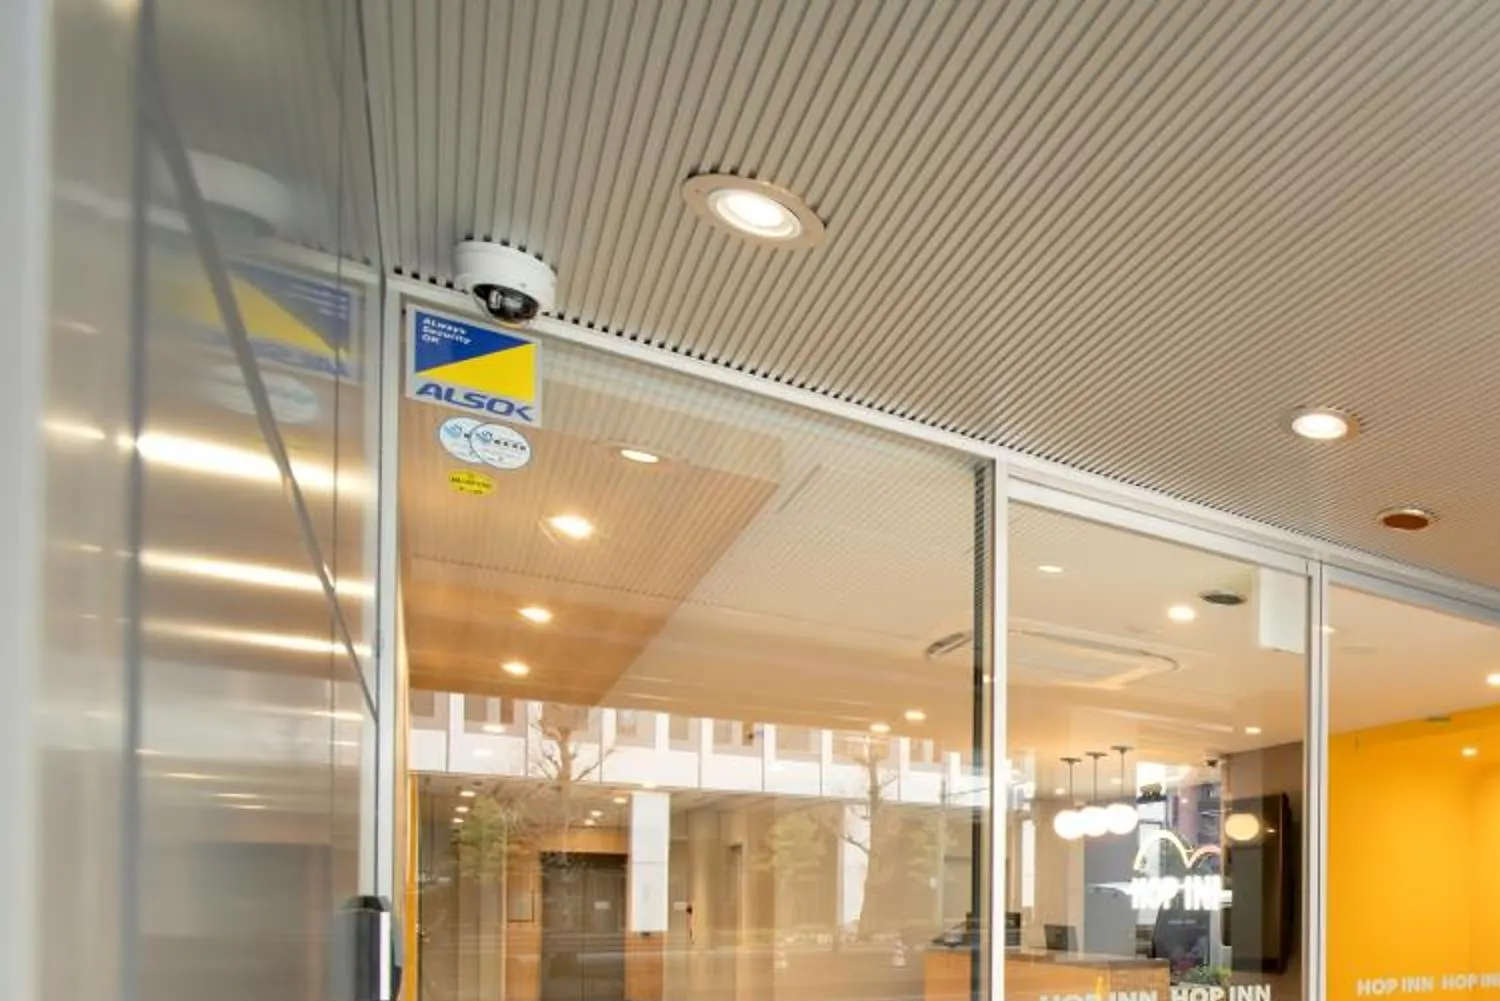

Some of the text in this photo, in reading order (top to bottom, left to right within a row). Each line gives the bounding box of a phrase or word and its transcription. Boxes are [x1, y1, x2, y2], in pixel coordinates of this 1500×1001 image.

[416, 383, 533, 422] ALSOK
[1355, 975, 1434, 996] HOP INN
[1441, 973, 1477, 991] HOP
